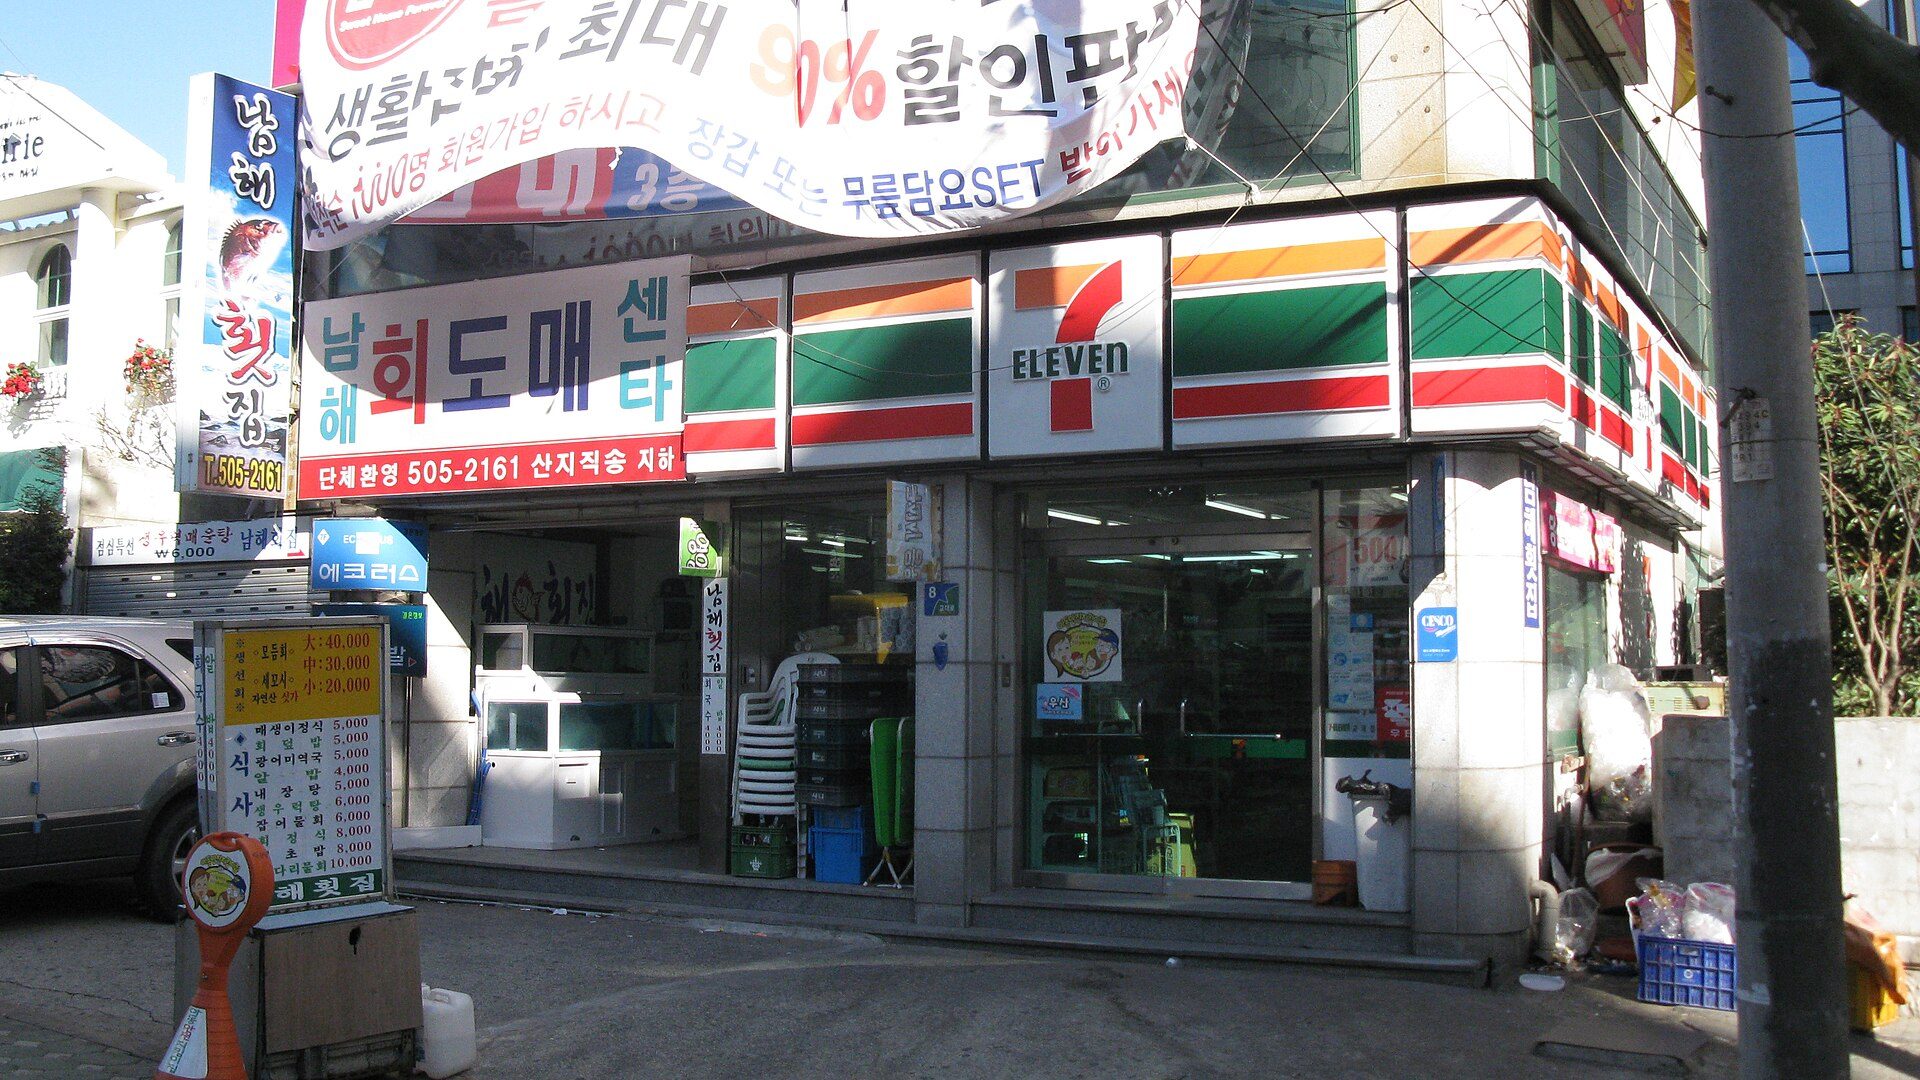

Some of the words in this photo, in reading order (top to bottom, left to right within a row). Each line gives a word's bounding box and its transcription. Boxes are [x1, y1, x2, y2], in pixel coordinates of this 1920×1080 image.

[438, 102, 551, 174] 회원가입
[559, 90, 667, 133] 하시고
[204, 455, 283, 491] T.505-2161
[319, 462, 399, 490] 단체환영
[407, 455, 519, 485] 505-2161
[531, 447, 627, 480] 산지직송
[637, 445, 675, 473] 지하
[319, 562, 420, 584] 에코러스
[928, 586, 937, 599] 8
[705, 583, 725, 673] 남해횟집
[1421, 613, 1455, 627] CESCO
